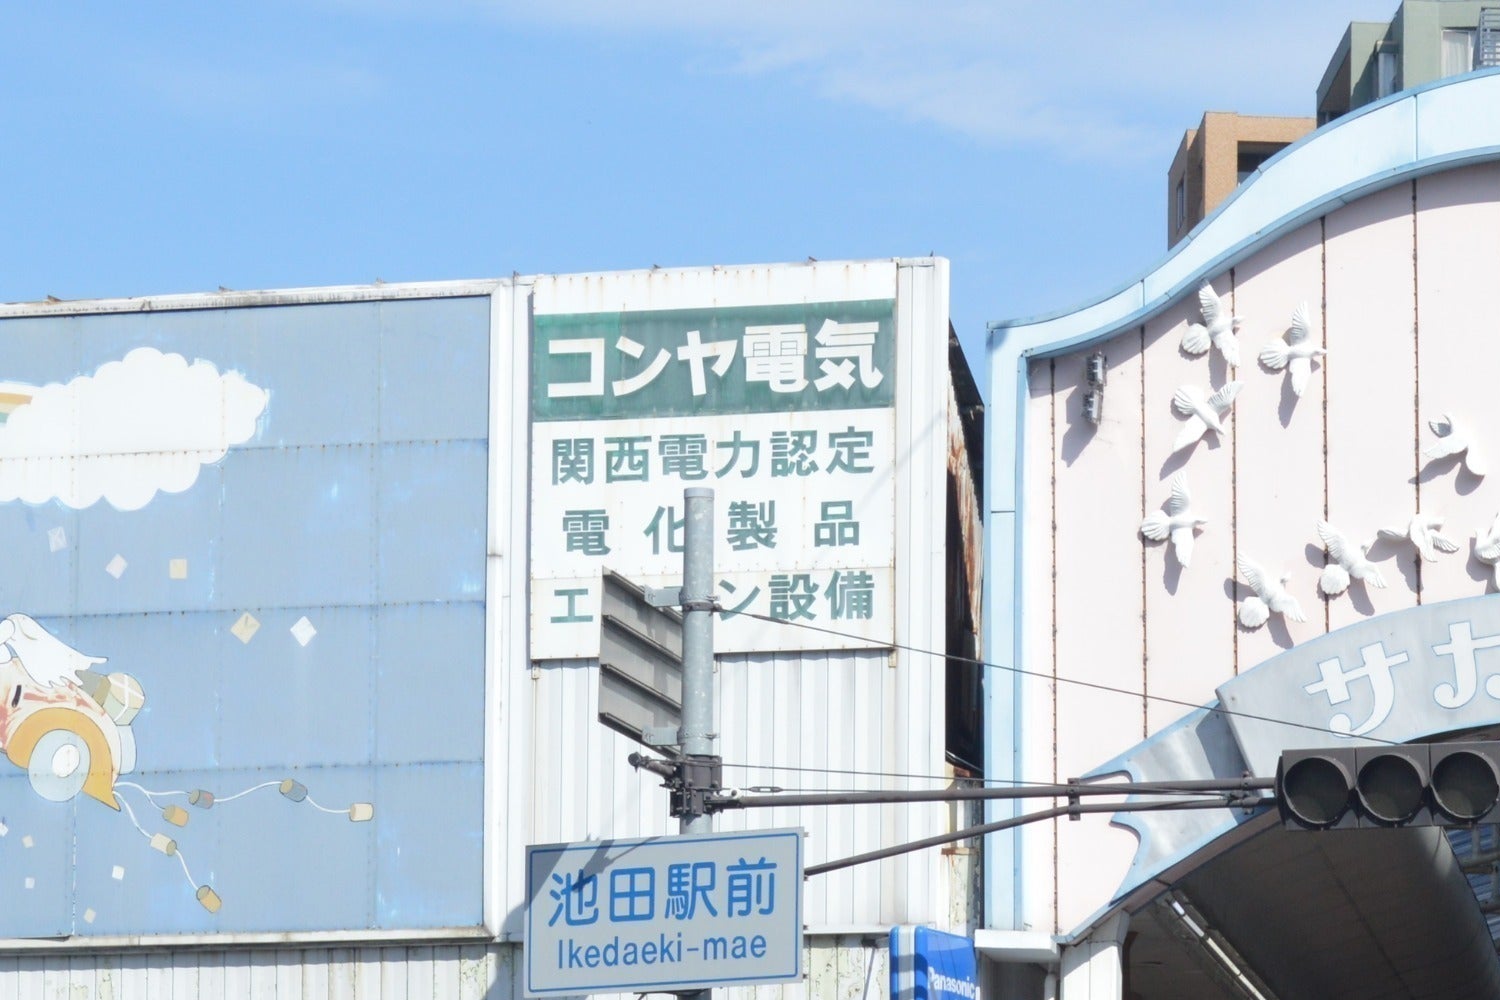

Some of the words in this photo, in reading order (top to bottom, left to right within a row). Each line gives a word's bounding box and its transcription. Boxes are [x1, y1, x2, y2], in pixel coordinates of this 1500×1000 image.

[547, 318, 884, 398] コンヤ電気
[551, 425, 876, 486] 関西電力認定
[550, 570, 876, 624] エン設備
[547, 856, 778, 928] 池田駅前
[557, 931, 768, 970] Ikedaeki-mae
[927, 965, 975, 1000] Panasonic
